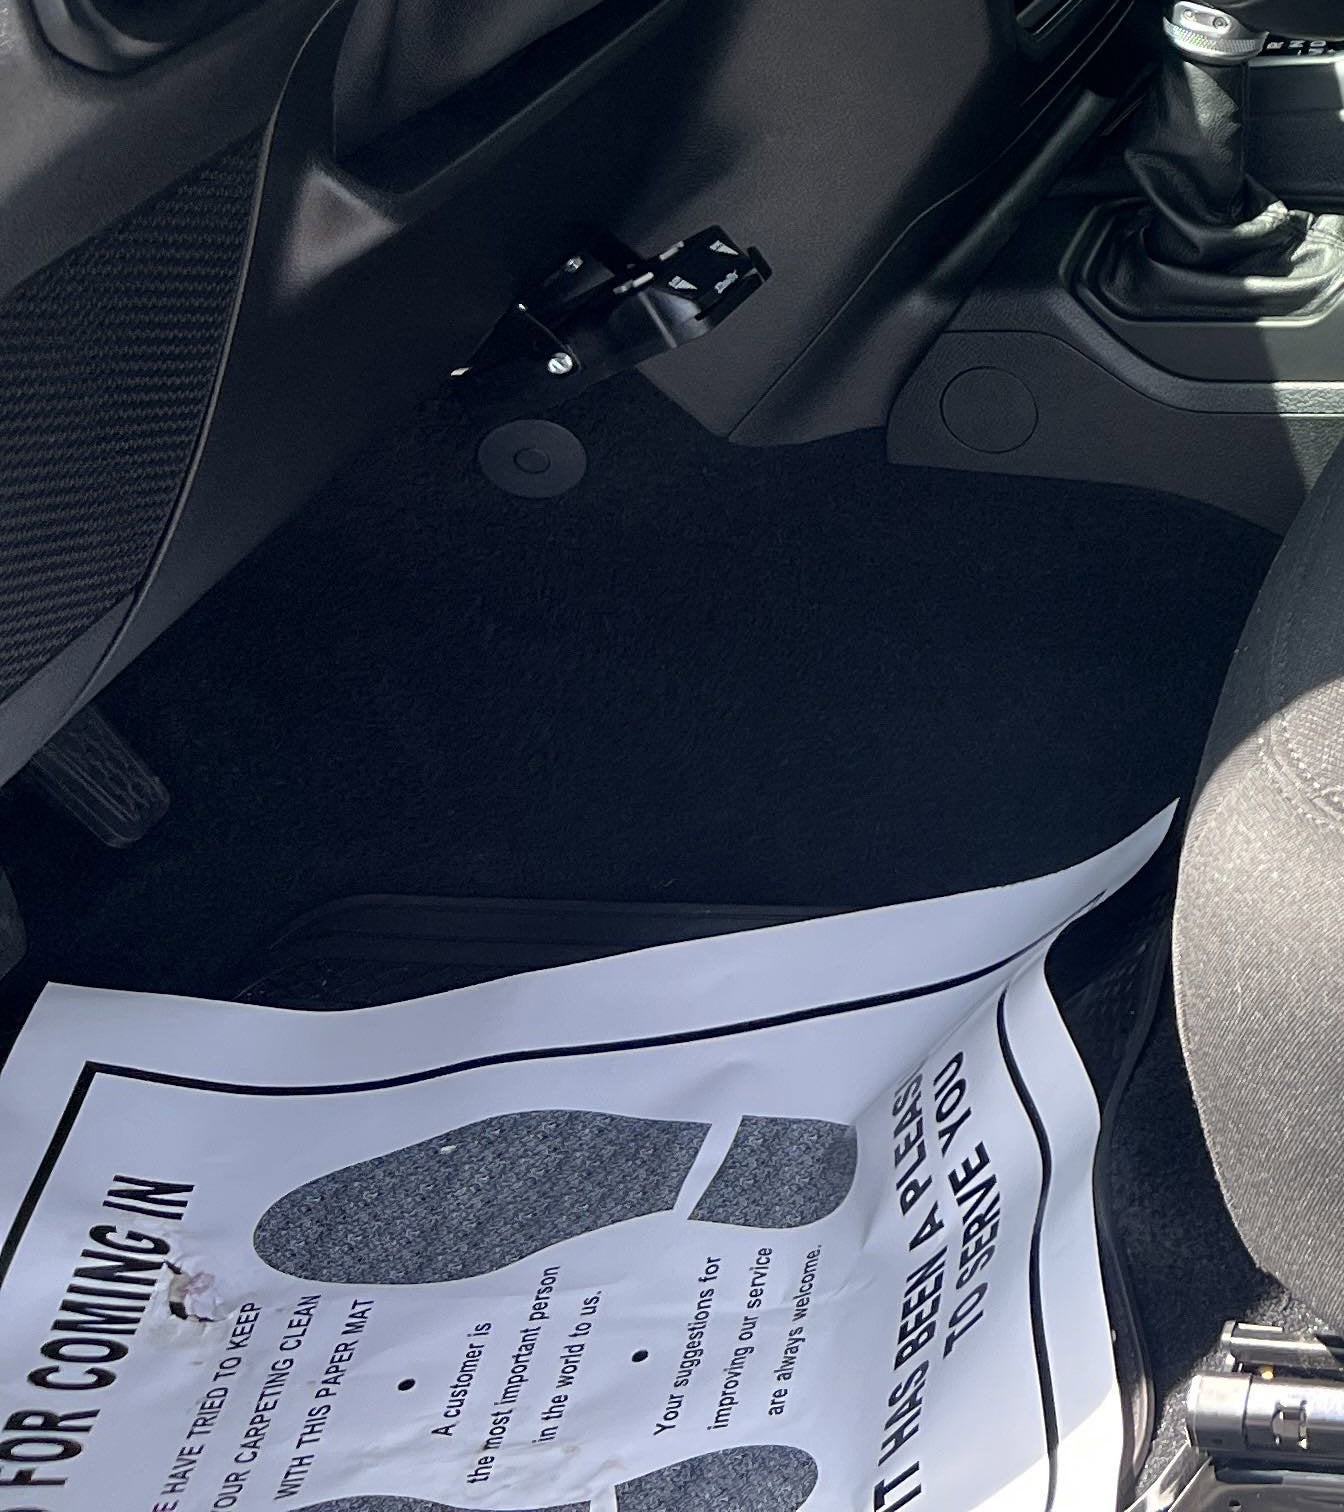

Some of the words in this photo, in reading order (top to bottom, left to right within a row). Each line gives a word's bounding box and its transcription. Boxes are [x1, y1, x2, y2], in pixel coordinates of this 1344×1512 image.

[932, 1050, 974, 1159] YOU
[102, 1174, 196, 1221] IN
[908, 1199, 946, 1253] A
[947, 1139, 1002, 1292] SERVE
[27, 1224, 171, 1390] COMING
[745, 1246, 775, 1311] service
[793, 1243, 824, 1323] welcome.
[893, 1244, 949, 1372] BEEN
[466, 1321, 493, 1341] is
[568, 1320, 592, 1342] to
[652, 1393, 685, 1437] Your
[674, 1287, 716, 1390] suggestions
[697, 1255, 723, 1283] for
[739, 1314, 761, 1342] our
[781, 1326, 808, 1382] always
[942, 1281, 990, 1360] TO
[161, 1444, 204, 1500] HAVE
[186, 1386, 229, 1444] TRIED
[213, 1350, 242, 1384] TO
[228, 1301, 264, 1350] KEEP
[211, 1468, 252, 1512] OUR
[234, 1352, 294, 1465] CARPETING
[279, 1293, 322, 1353] CLEAN
[273, 1451, 315, 1501] WITH
[295, 1403, 332, 1451] THIS
[314, 1337, 359, 1399] PAPER
[342, 1298, 375, 1336] MAT
[443, 1342, 487, 1420] customer
[466, 1455, 496, 1485] the
[482, 1404, 514, 1452] most
[499, 1326, 541, 1408] important
[529, 1264, 561, 1321] person
[556, 1342, 586, 1392] world
[706, 1344, 756, 1431] improving
[768, 1387, 789, 1418] are
[0, 1407, 100, 1487] FOR
[430, 1422, 457, 1438] A
[531, 1422, 558, 1445] in
[538, 1394, 569, 1424] the
[877, 1358, 931, 1468] HAS
[873, 1460, 923, 1512] IT
